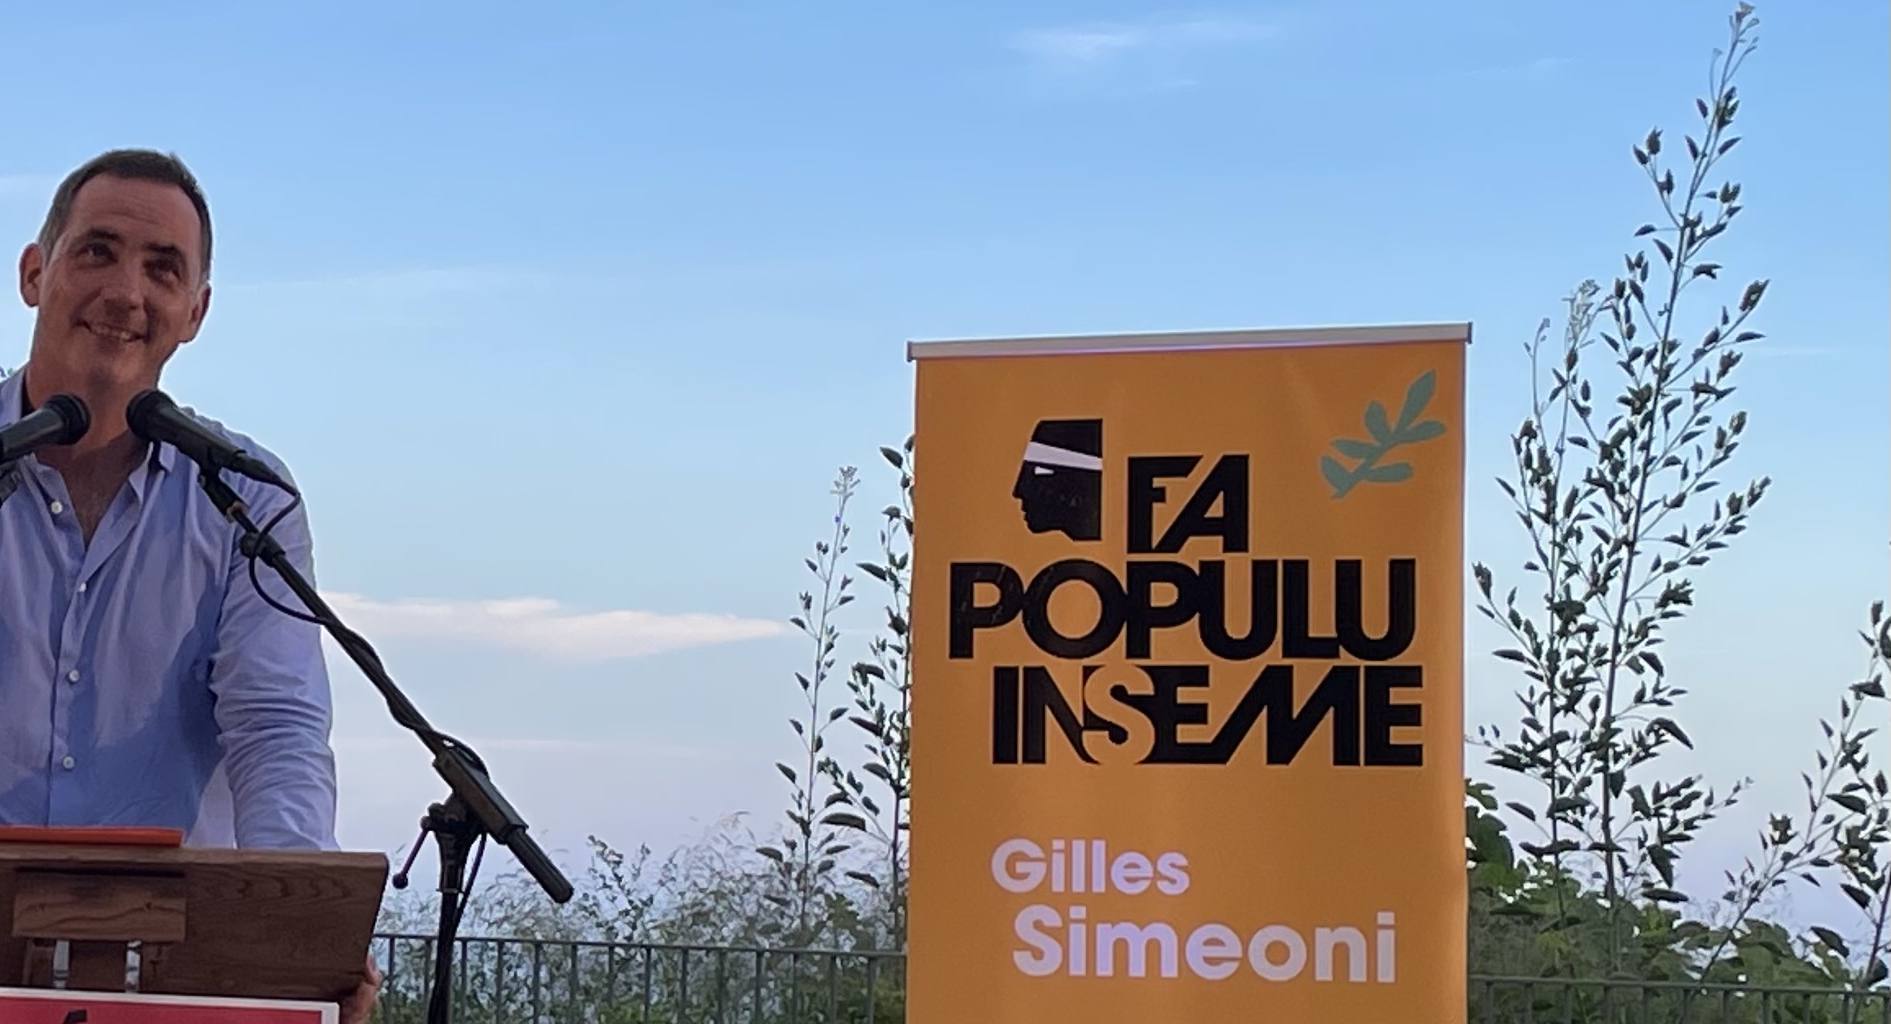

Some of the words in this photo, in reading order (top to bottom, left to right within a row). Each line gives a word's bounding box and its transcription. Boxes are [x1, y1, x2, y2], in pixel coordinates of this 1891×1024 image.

[1127, 454, 1250, 554] FA
[949, 558, 1416, 660] POPULU
[992, 664, 1424, 767] INSEME
[992, 838, 1190, 895] Gilles
[1013, 904, 1397, 983] Simeoni
